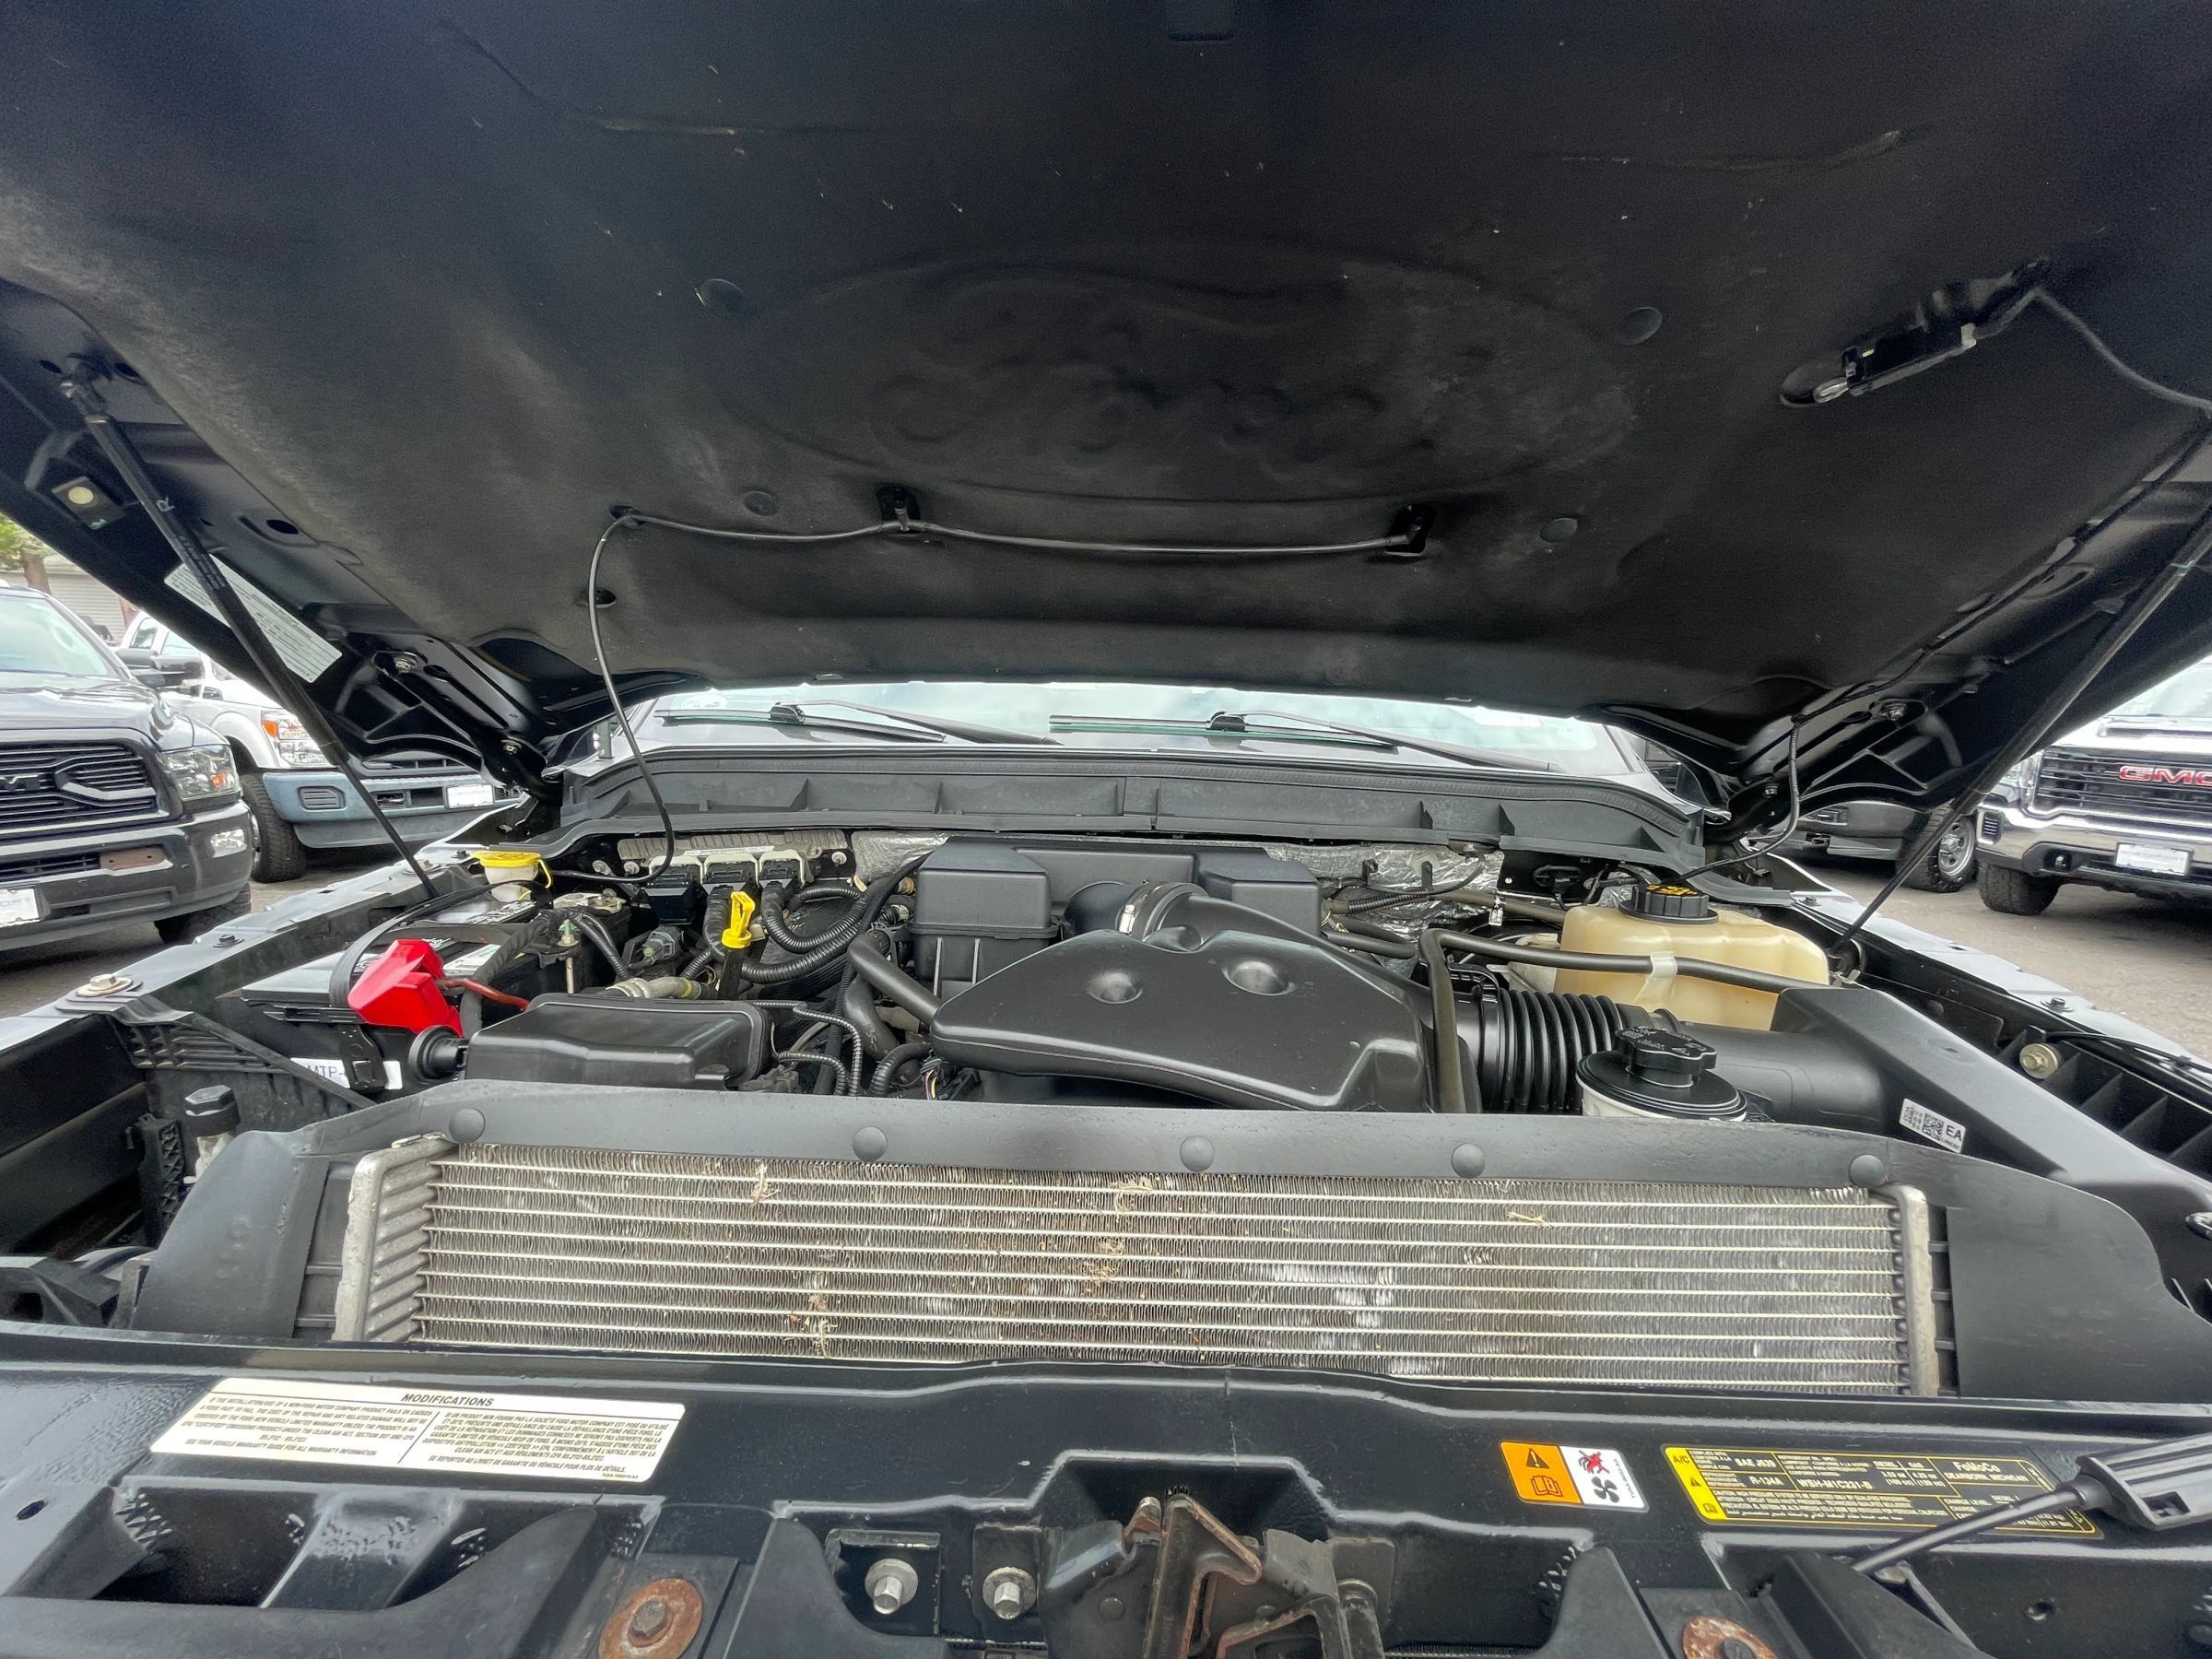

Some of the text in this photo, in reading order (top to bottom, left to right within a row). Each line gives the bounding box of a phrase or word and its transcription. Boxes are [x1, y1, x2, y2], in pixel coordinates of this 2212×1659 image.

[1946, 1124, 1962, 1142] EA
[399, 1393, 496, 1406] MODIFICATIONS
[1672, 1455, 1690, 1464] A/C
[1735, 1458, 1755, 1467] SAE
[1952, 1461, 2002, 1473] FoMoCo
[1748, 1477, 1784, 1486] R-134A
[1989, 1474, 2030, 1482] MICHIGAN
